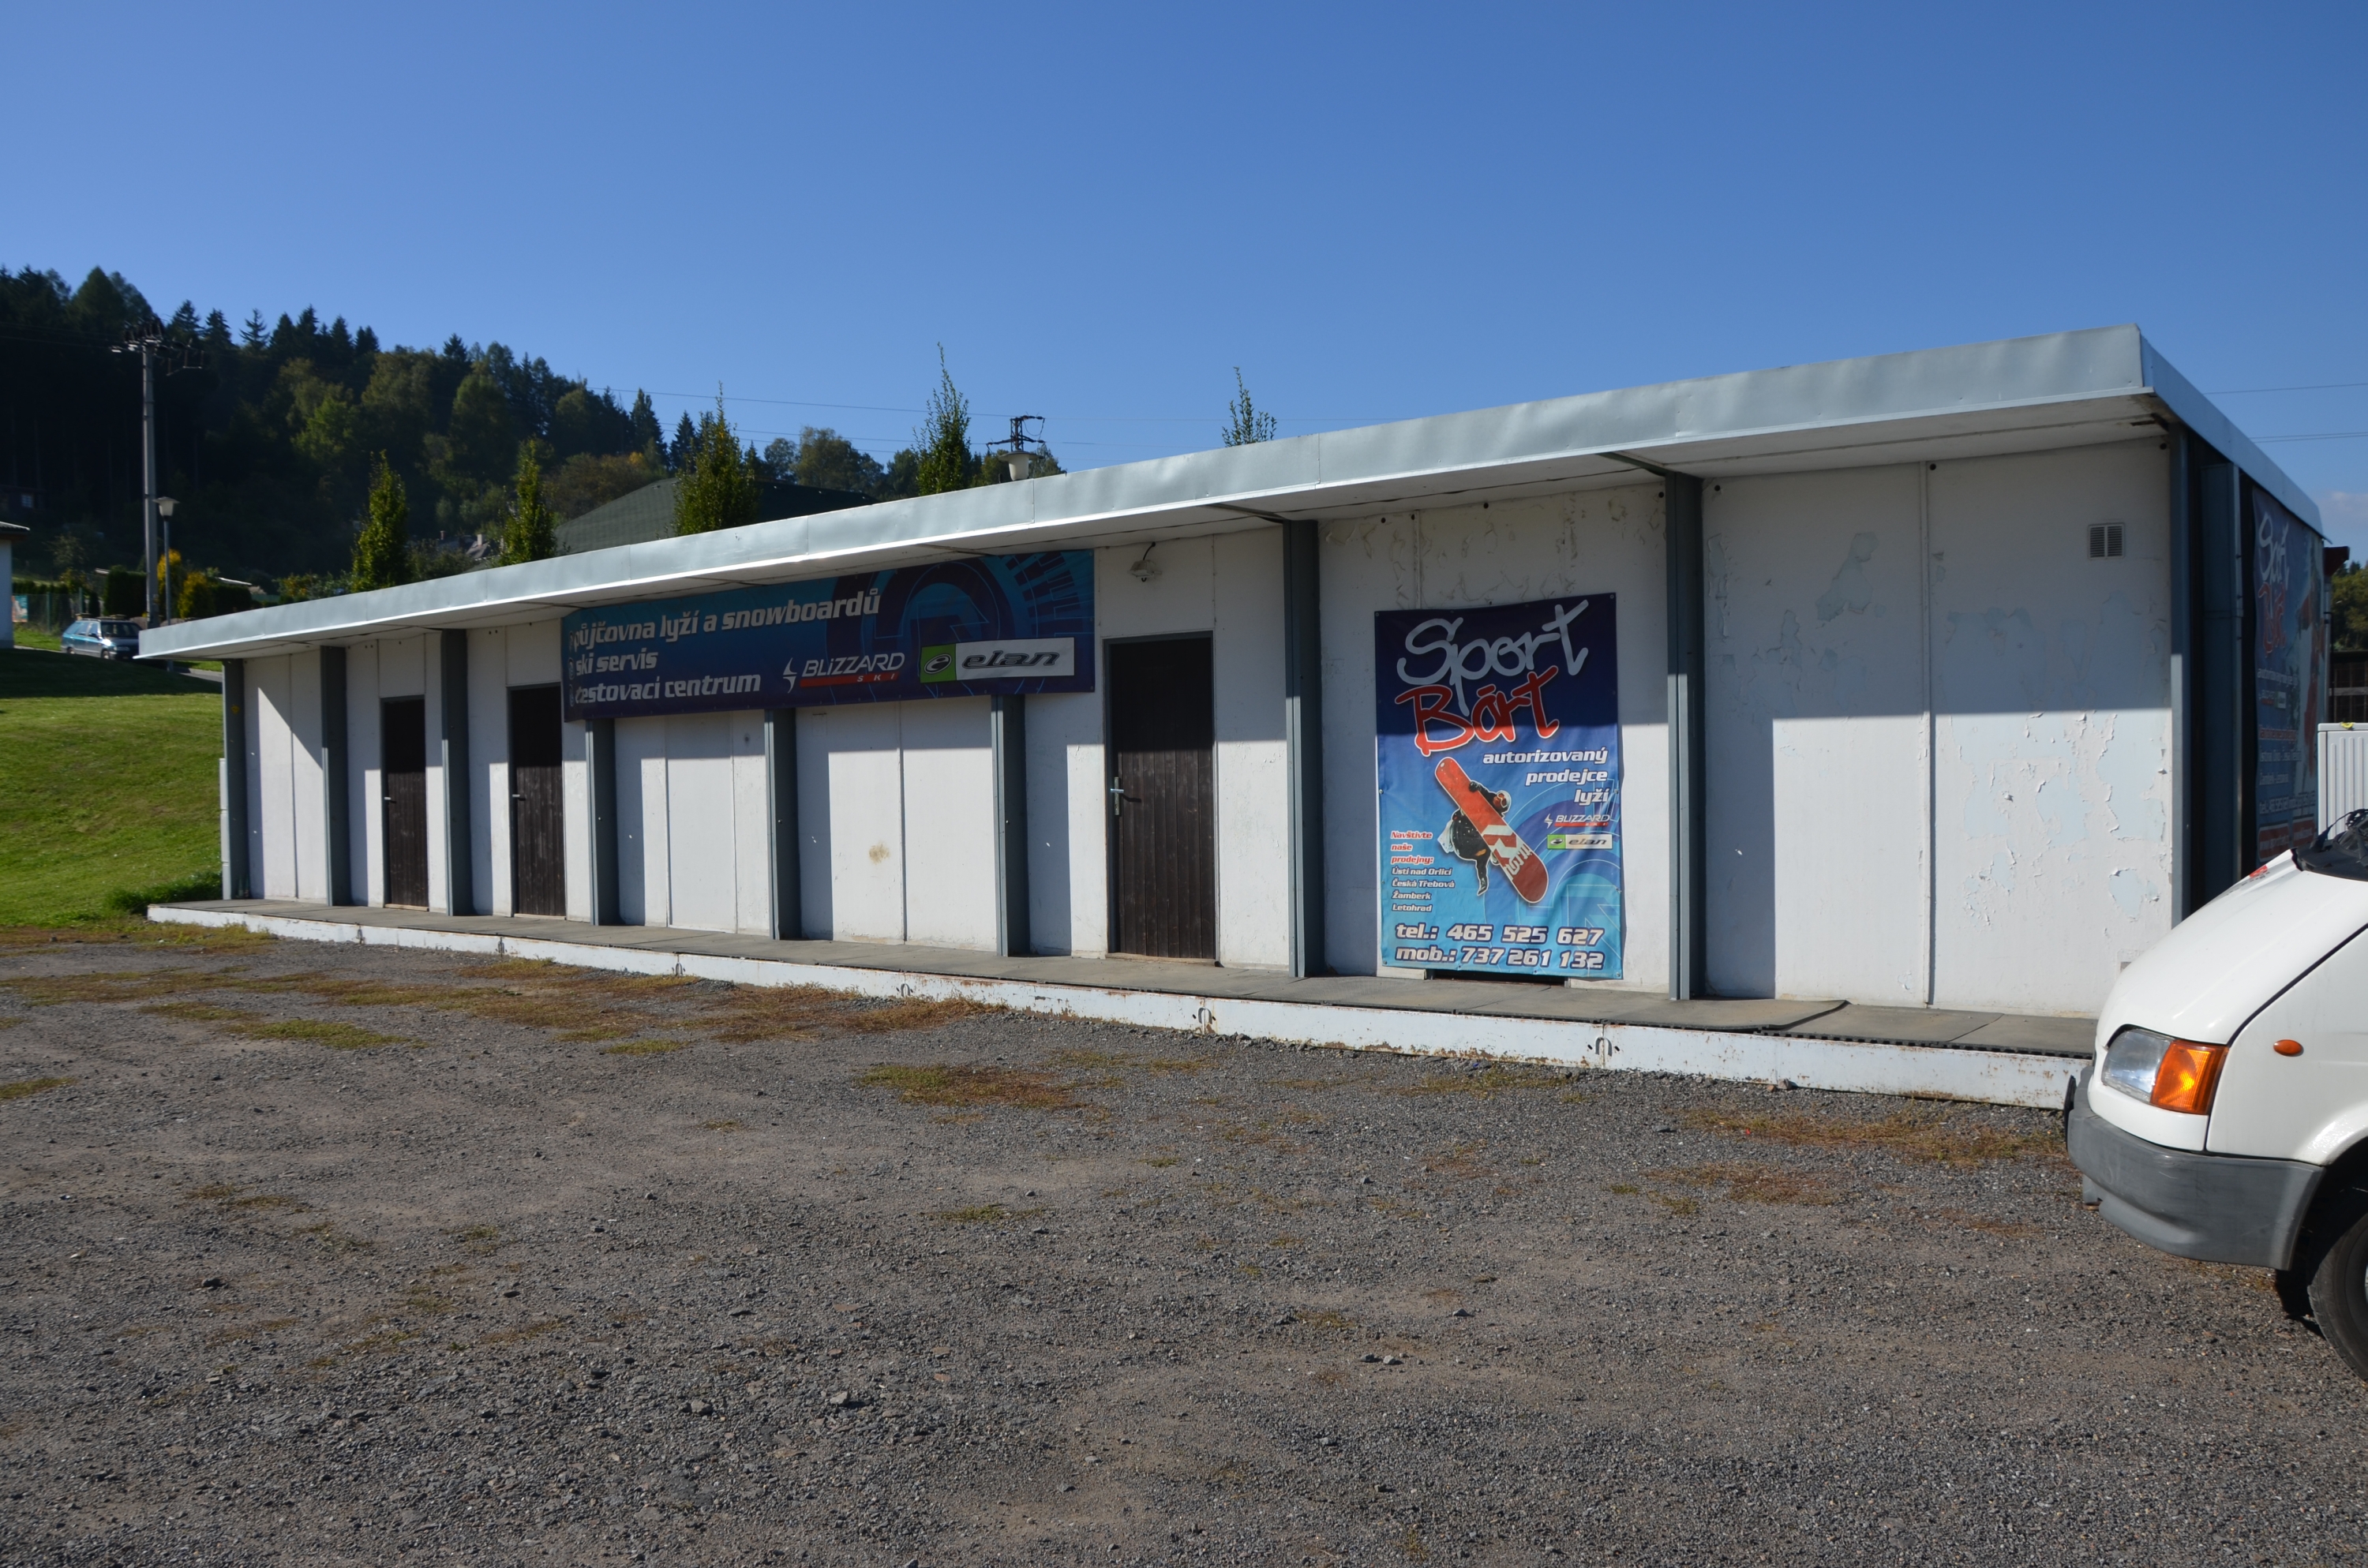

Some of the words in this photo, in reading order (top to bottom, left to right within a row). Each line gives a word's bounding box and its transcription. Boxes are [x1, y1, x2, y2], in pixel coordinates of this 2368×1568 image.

[574, 621, 655, 652] půjčovna
[660, 610, 699, 642] lyží
[703, 614, 718, 632] a
[721, 588, 881, 630] snowboardů
[575, 653, 594, 675] ski
[596, 648, 658, 672] servis
[961, 650, 1060, 669] elan
[1397, 599, 1589, 717] Sport
[665, 674, 761, 698] centrum
[1482, 747, 1609, 764] autorizovaný
[1525, 769, 1608, 786] prodejce
[1574, 788, 1610, 806] lyží
[1391, 855, 1434, 865] prodejny:
[1392, 866, 1409, 875] Ústí
[1392, 878, 1417, 887] Česká
[1392, 890, 1432, 900] Žamberk
[1396, 923, 1438, 939] tel.:
[1447, 924, 1493, 941] 465
[1502, 926, 1548, 943] 525
[1557, 928, 1604, 945] 627
[1396, 946, 1456, 961] mob.:
[1462, 948, 1504, 964] 737
[1507, 949, 1552, 967] 261
[1559, 951, 1604, 968] 132
